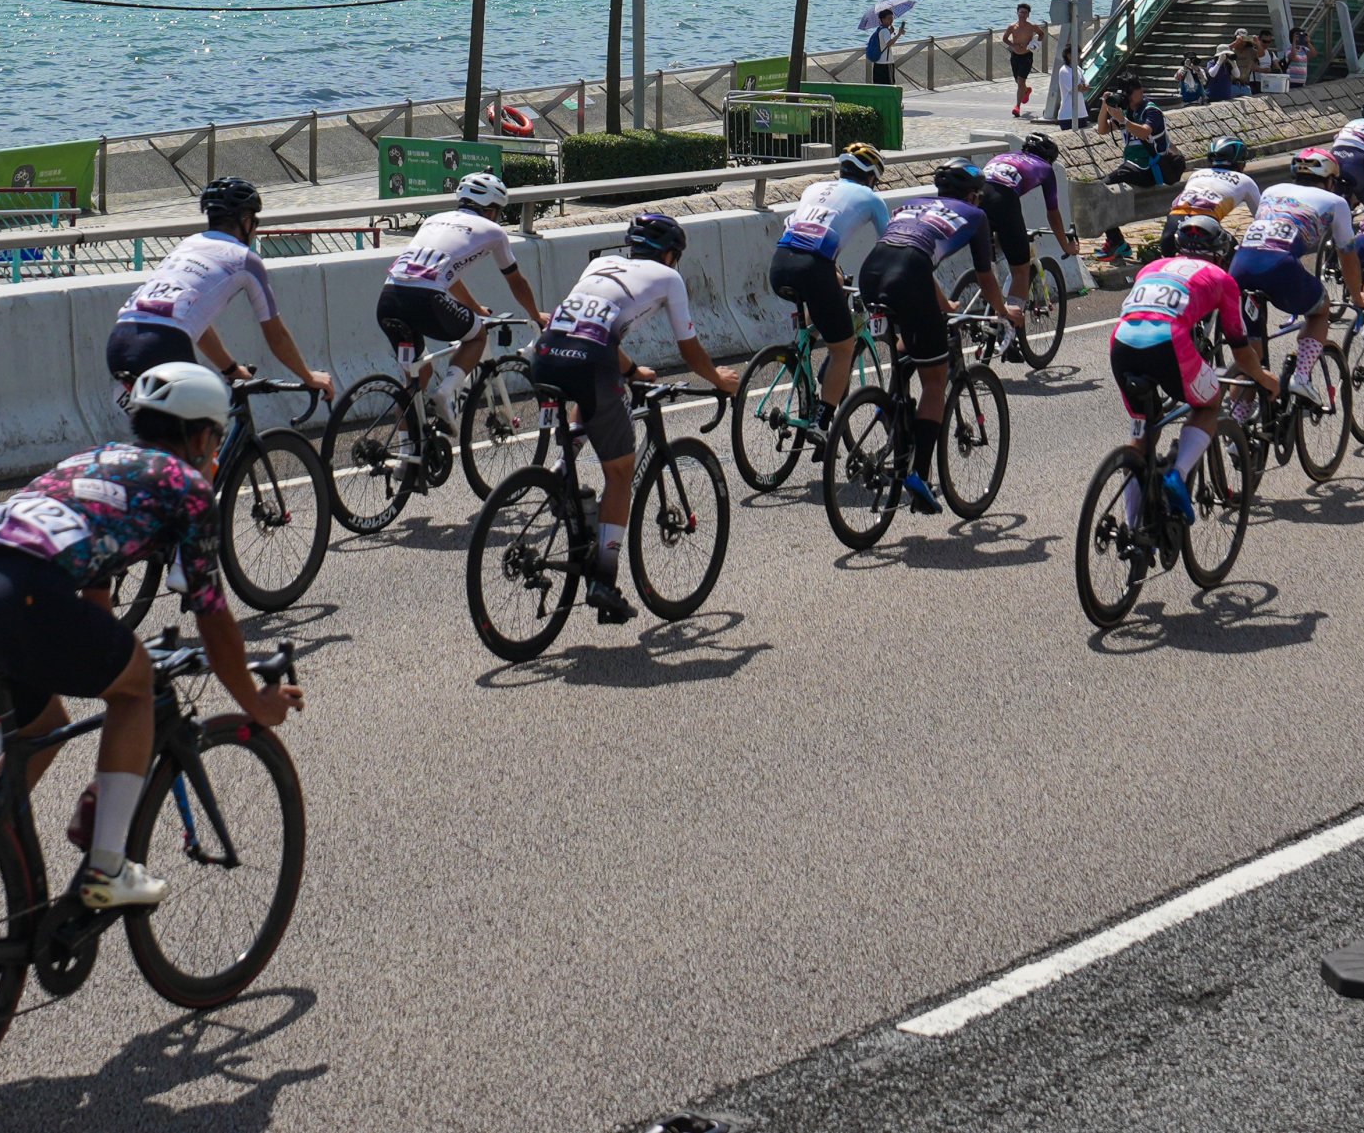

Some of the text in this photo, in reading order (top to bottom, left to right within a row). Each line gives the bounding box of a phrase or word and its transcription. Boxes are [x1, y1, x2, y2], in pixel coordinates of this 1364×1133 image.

[805, 208, 827, 224] 114
[1246, 224, 1265, 241] 39
[1268, 221, 1293, 239] 39
[453, 248, 485, 271] RUDY
[1153, 285, 1182, 309] 20
[555, 299, 583, 323] 84
[585, 299, 612, 323] 84
[874, 318, 883, 334] 97
[549, 347, 588, 359] SUCCESS
[543, 408, 553, 426] 84
